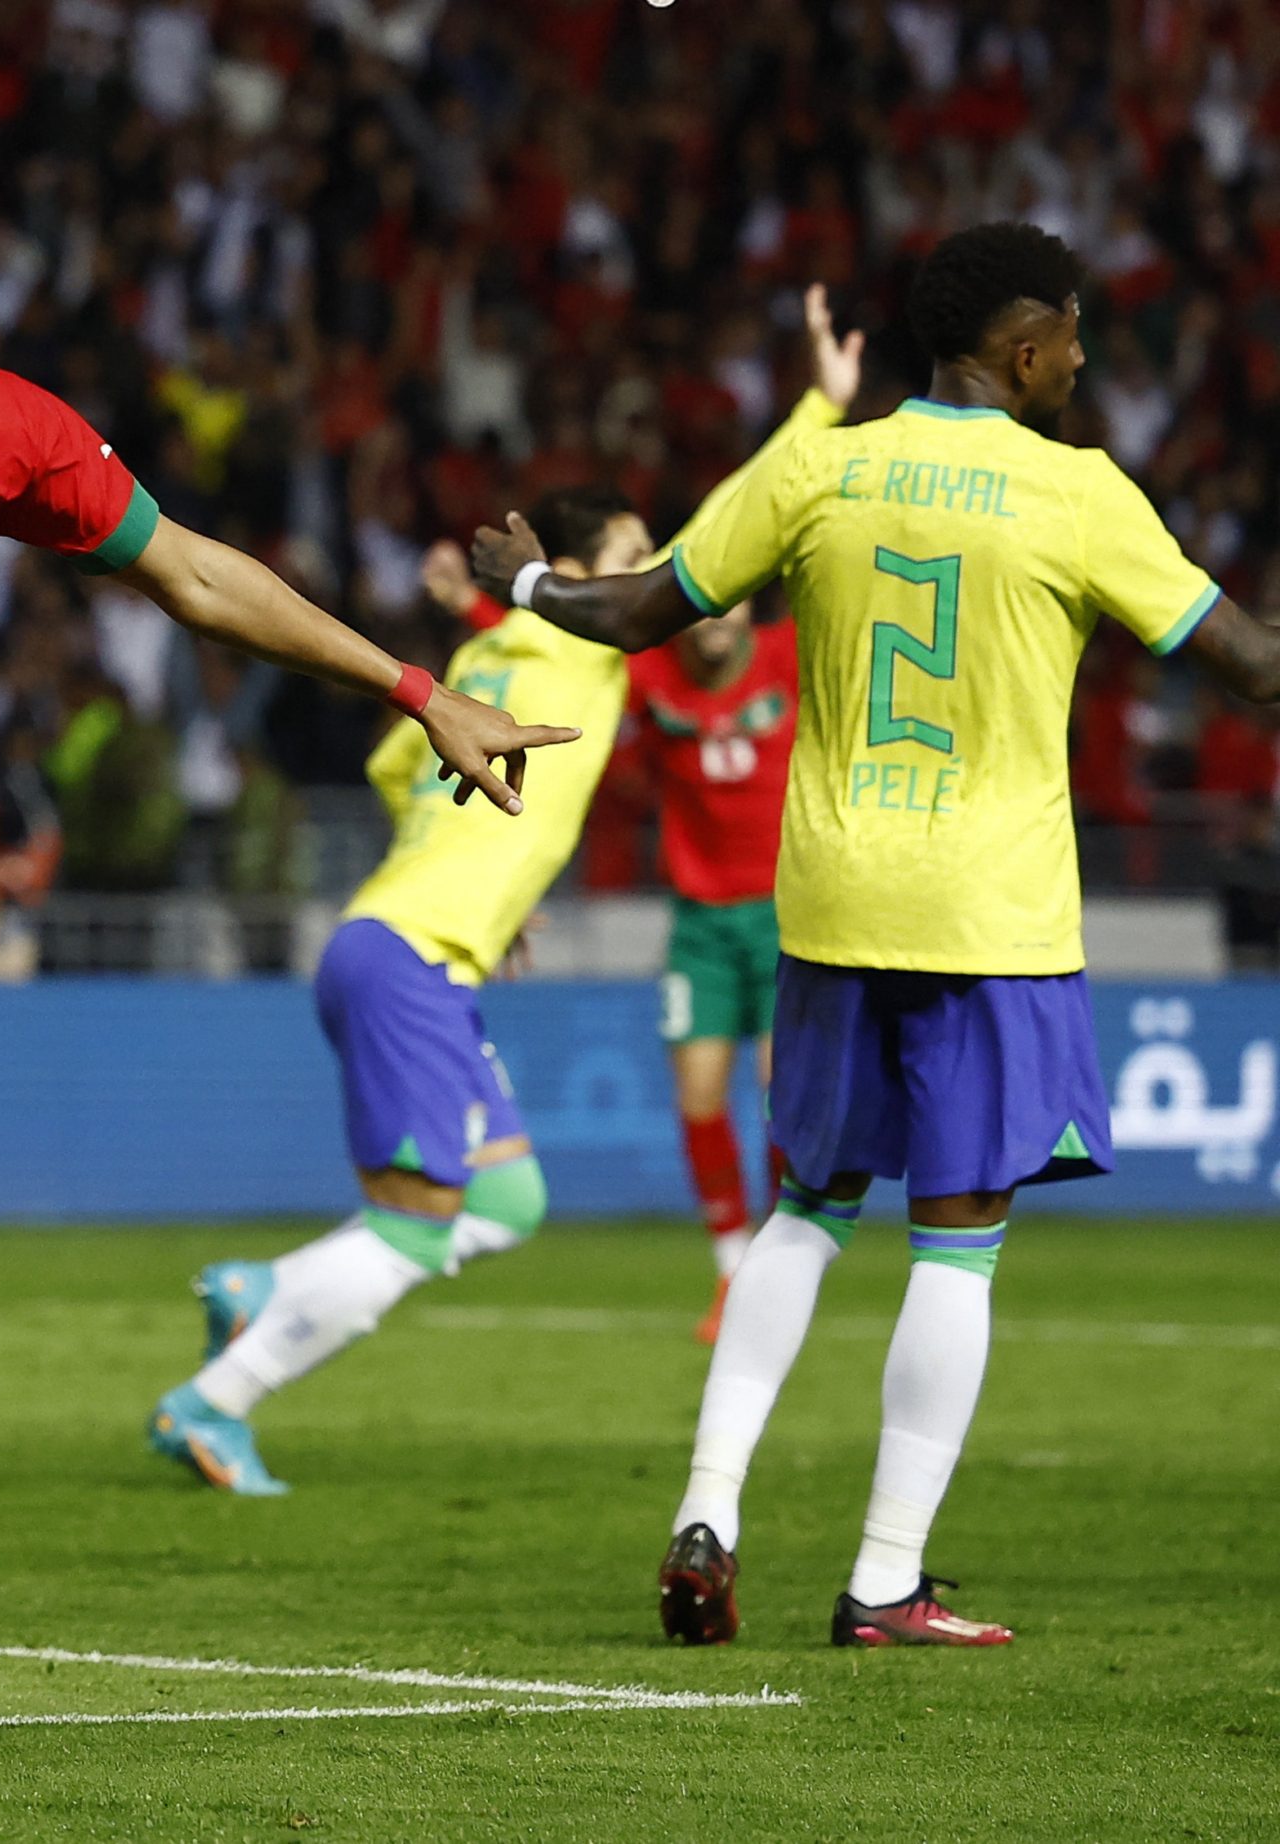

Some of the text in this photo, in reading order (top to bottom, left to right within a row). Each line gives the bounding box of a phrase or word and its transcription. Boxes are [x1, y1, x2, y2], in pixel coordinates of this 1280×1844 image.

[838, 458, 1018, 518] E. ROYAL
[866, 544, 962, 755] 2
[850, 756, 962, 813] PELÉ
